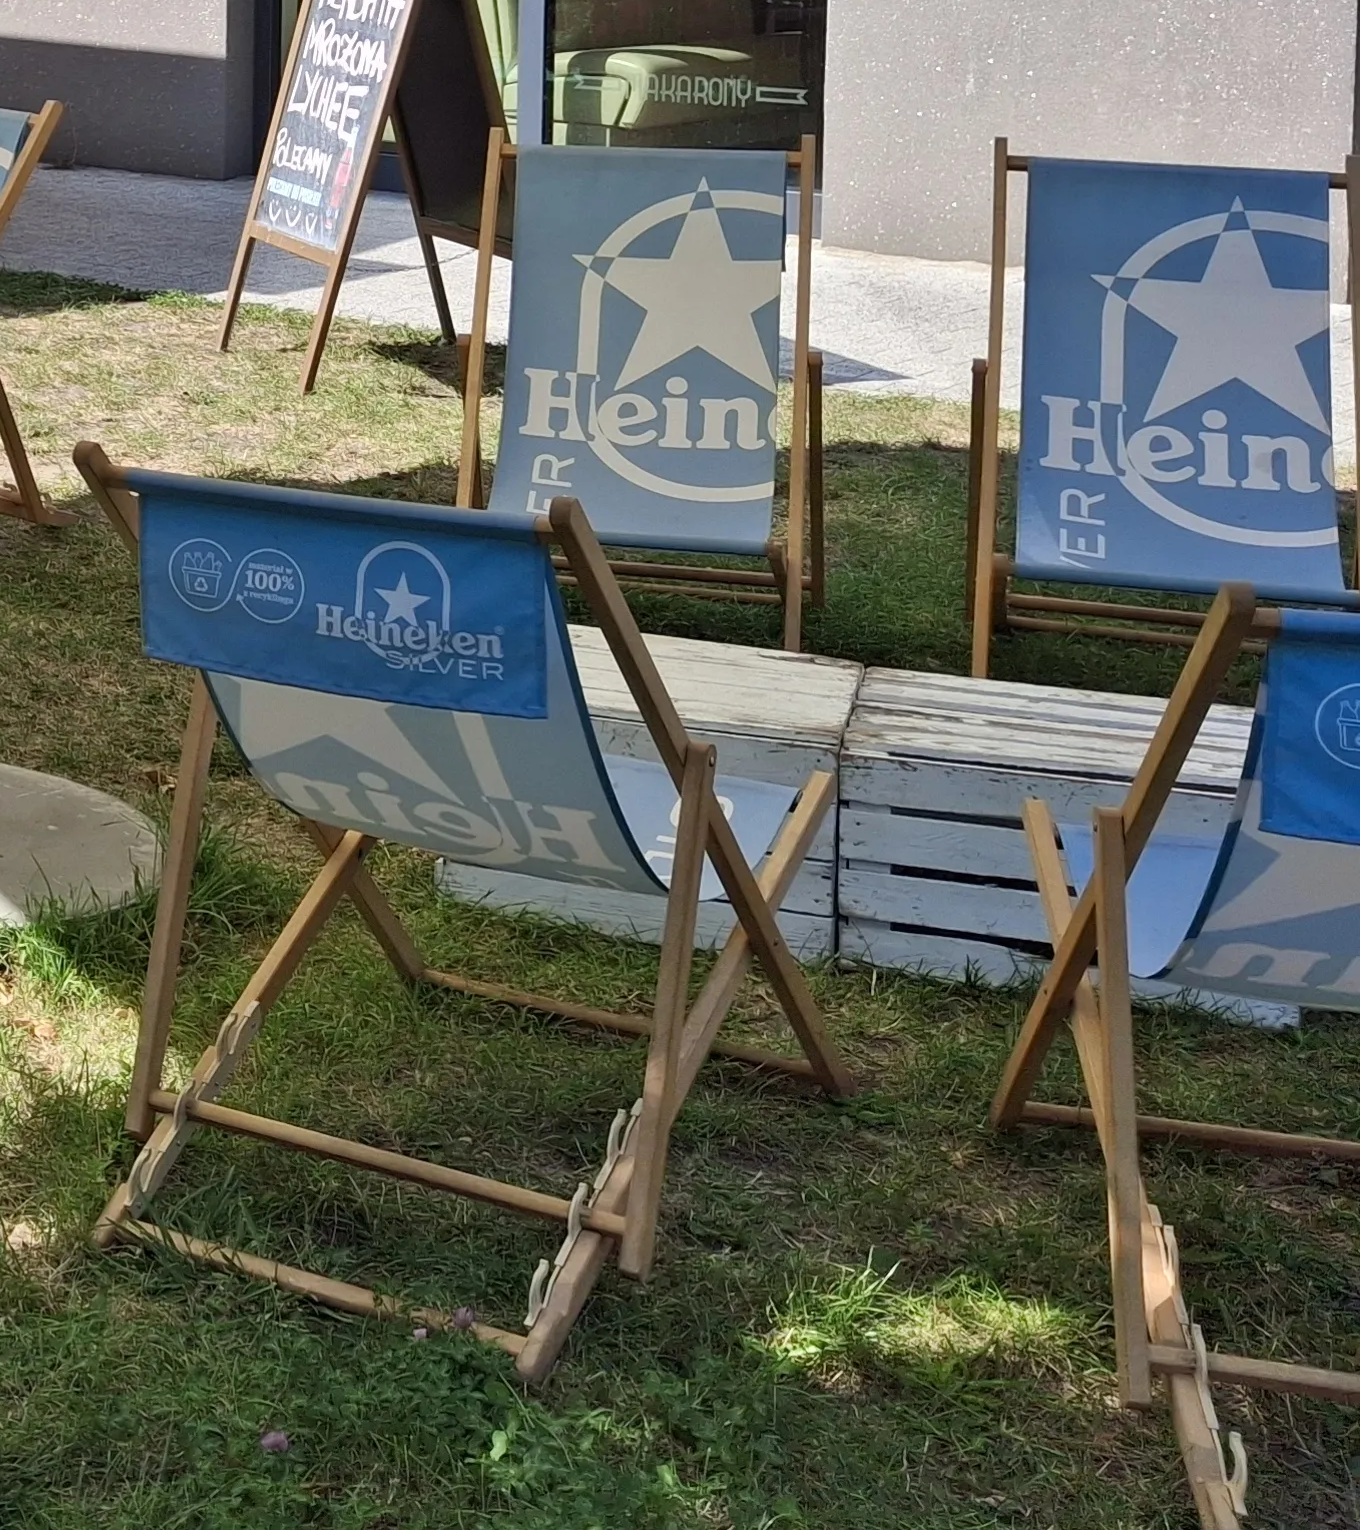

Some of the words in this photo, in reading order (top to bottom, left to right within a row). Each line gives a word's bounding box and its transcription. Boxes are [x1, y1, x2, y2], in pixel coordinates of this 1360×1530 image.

[286, 64, 370, 142] LYCHEE
[272, 127, 333, 186] POLECAMY
[518, 367, 776, 451] Hein
[1038, 394, 1336, 494] Hein
[244, 569, 295, 592] 100%
[315, 602, 505, 660] Heineken
[385, 649, 505, 682] SILVER
